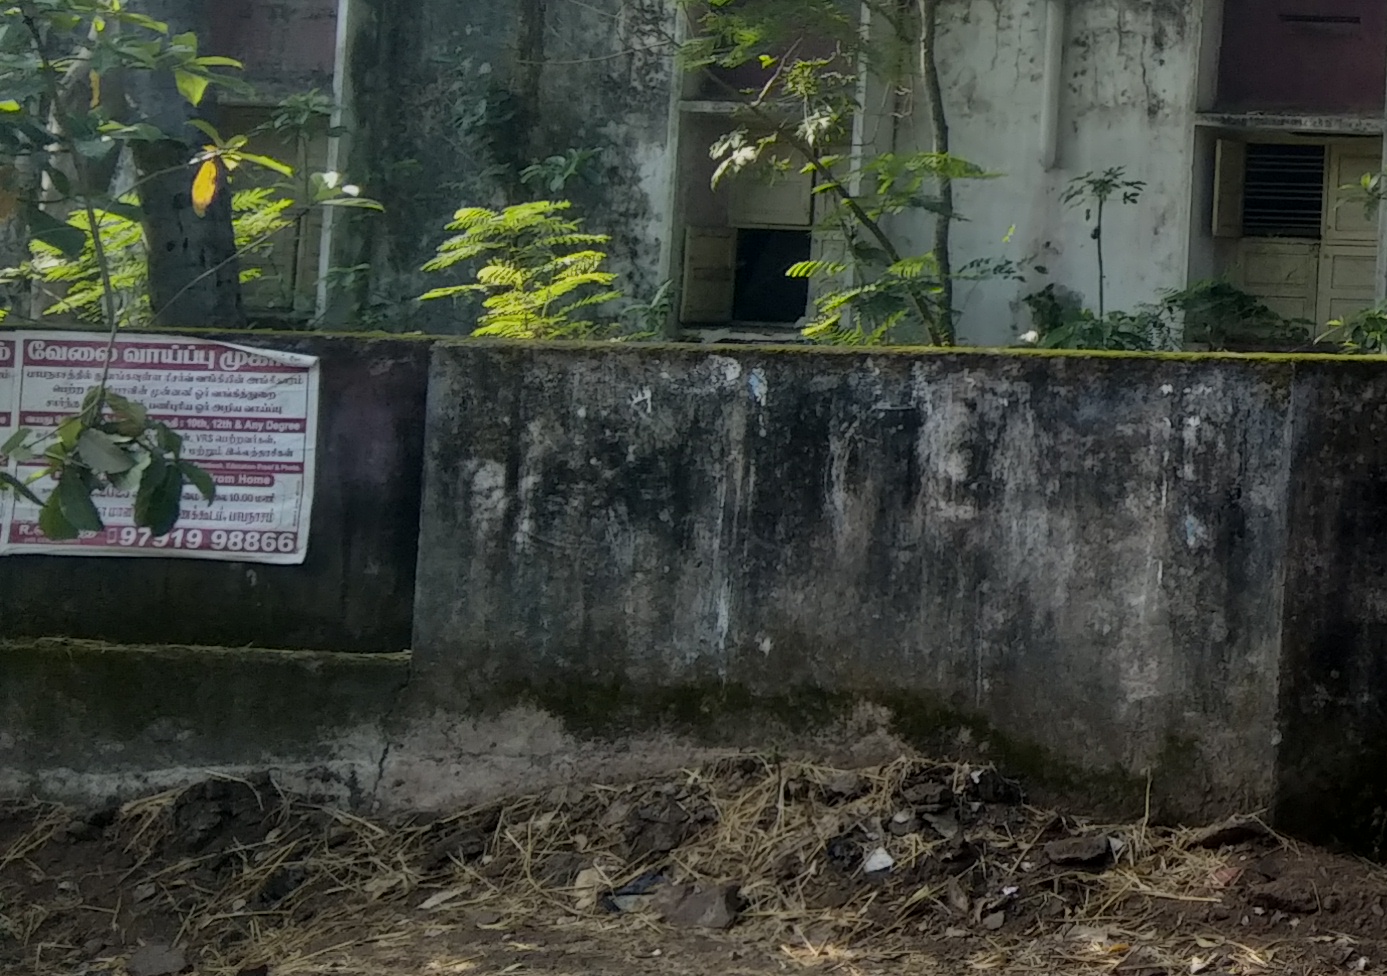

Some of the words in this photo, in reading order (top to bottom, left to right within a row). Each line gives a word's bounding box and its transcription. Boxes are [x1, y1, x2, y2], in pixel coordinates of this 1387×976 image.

[27, 340, 118, 363] வேலை
[123, 344, 214, 370] வாய்ப்பு
[212, 419, 232, 429] 12th
[244, 420, 264, 431] Any
[266, 421, 301, 433] Degree
[211, 473, 235, 484] rom
[238, 474, 271, 485] Home
[229, 493, 253, 502] 10.00
[210, 531, 294, 552] 98866
